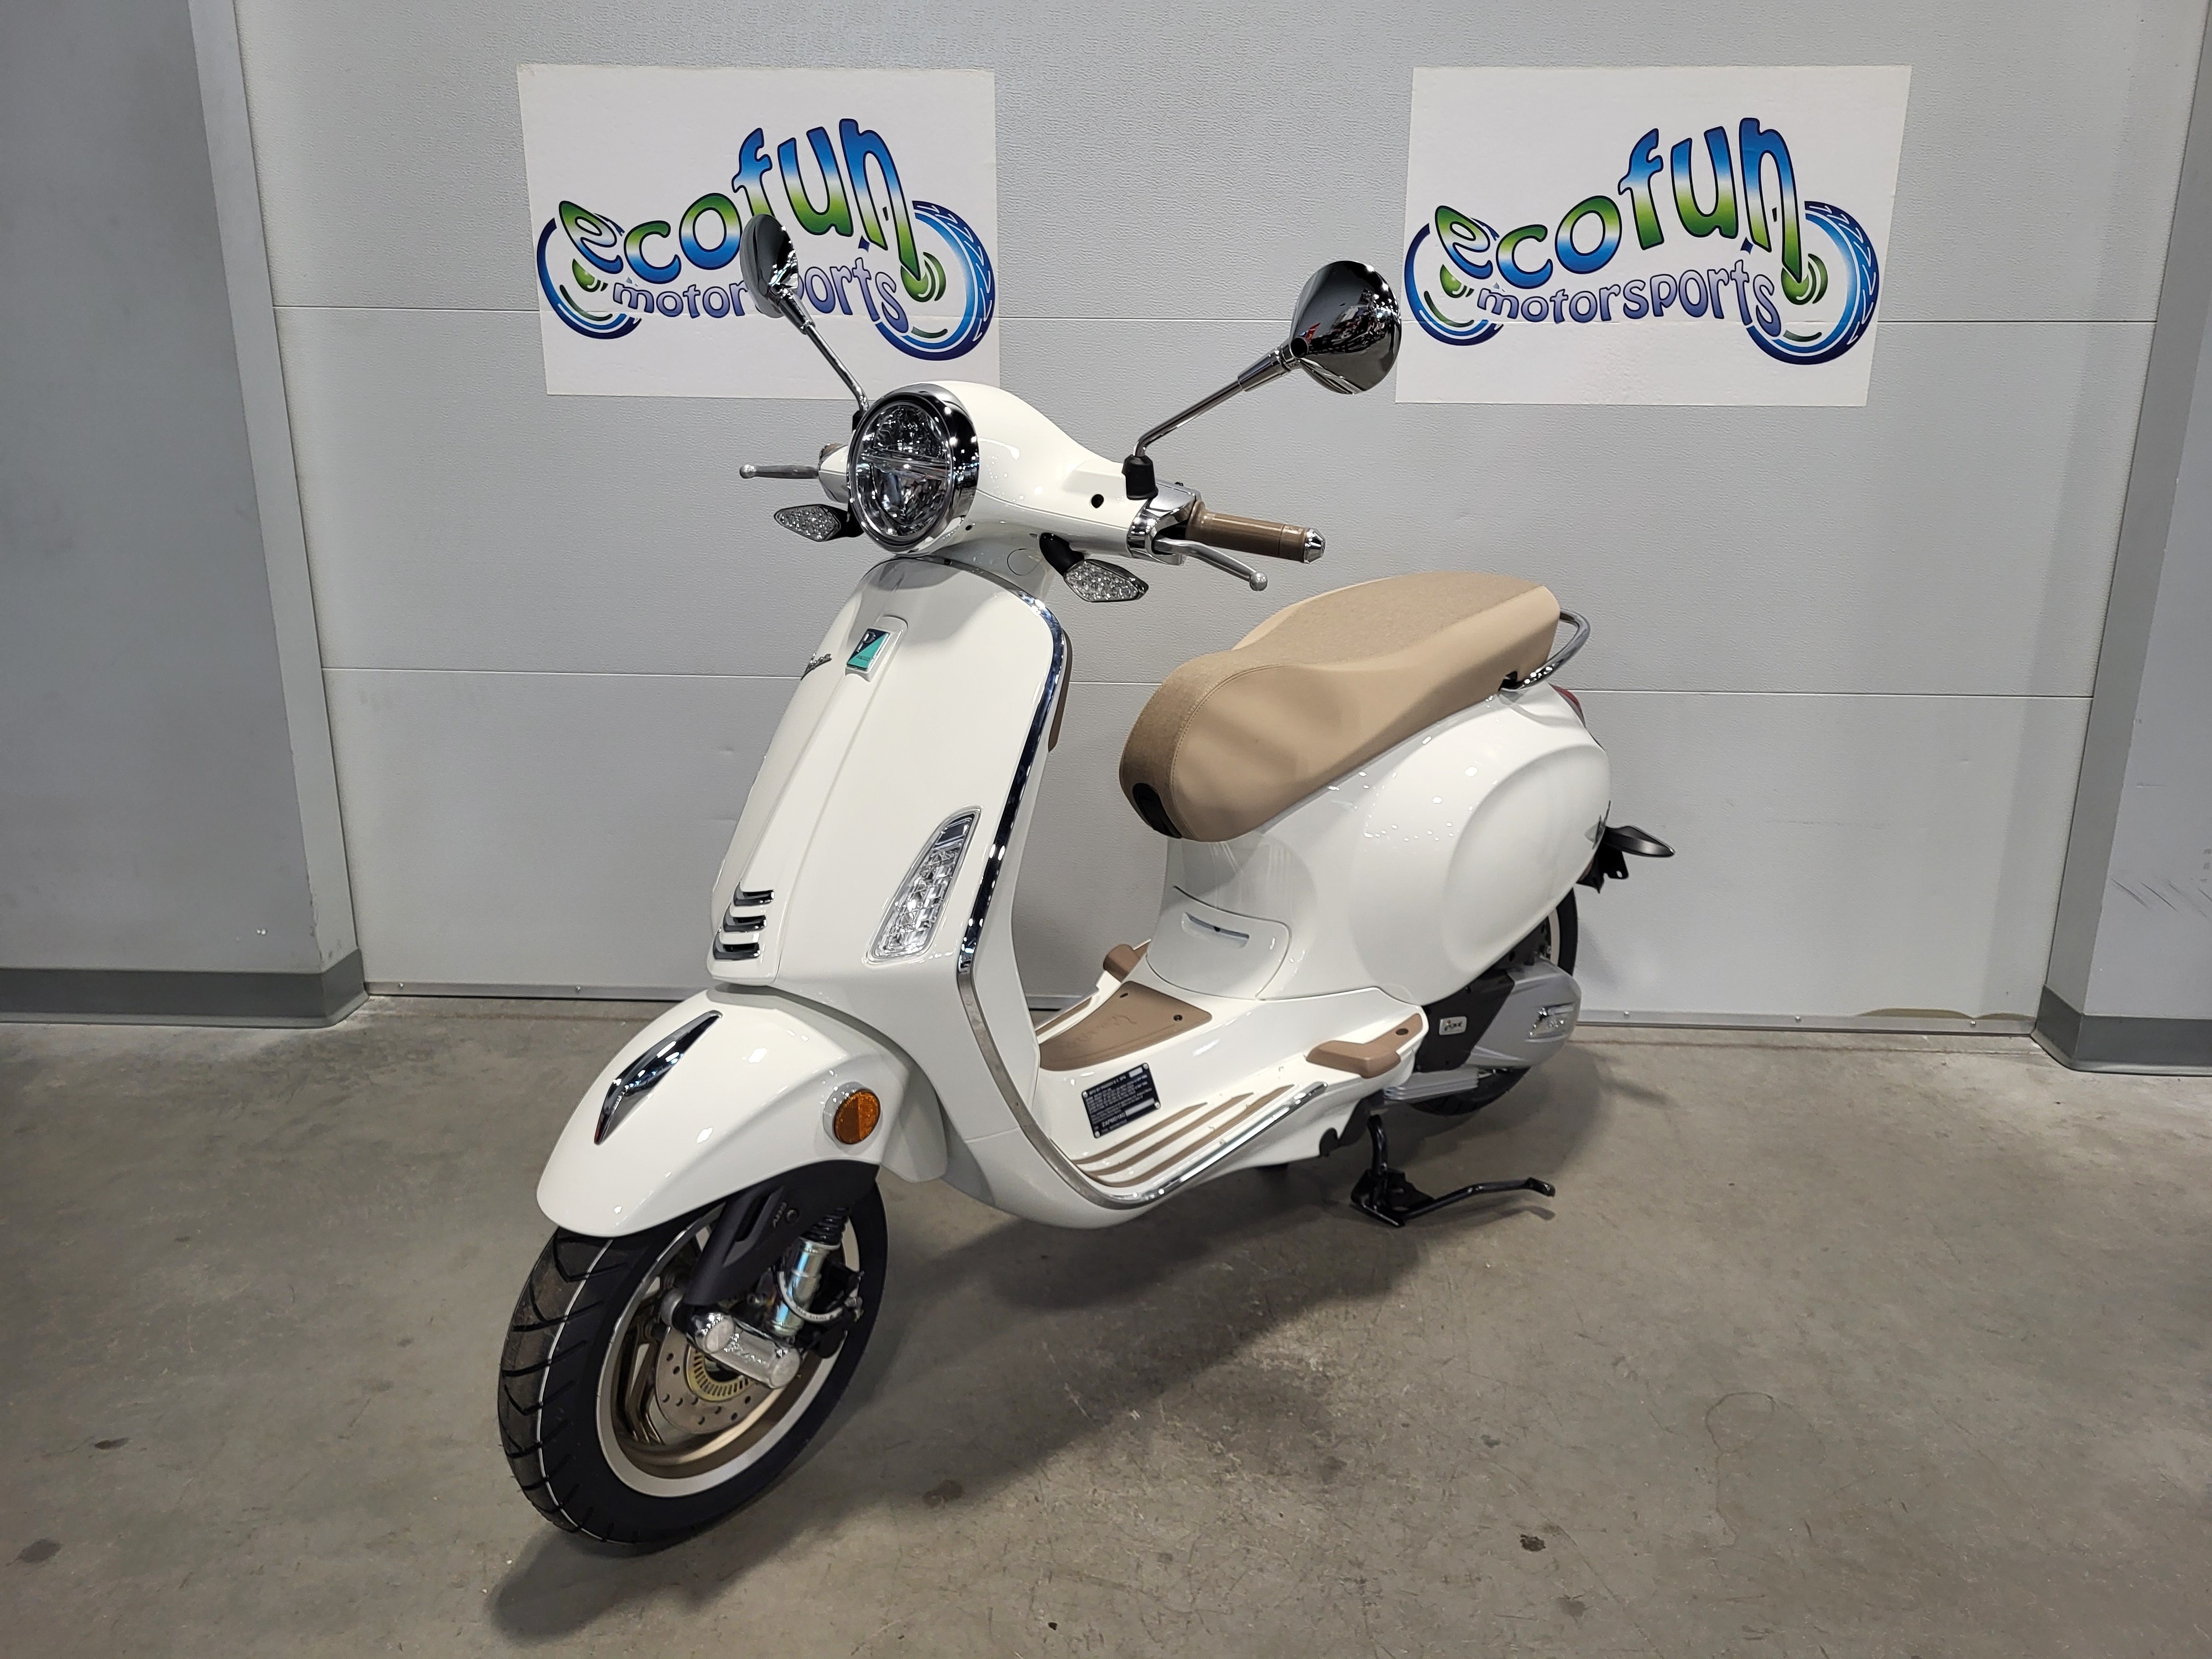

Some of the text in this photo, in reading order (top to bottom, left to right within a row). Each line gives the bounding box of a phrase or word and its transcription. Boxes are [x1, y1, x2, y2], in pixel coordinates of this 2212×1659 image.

[1434, 118, 1803, 289] ecofun
[613, 257, 909, 333] motororts
[1477, 259, 1782, 337] motorsports
